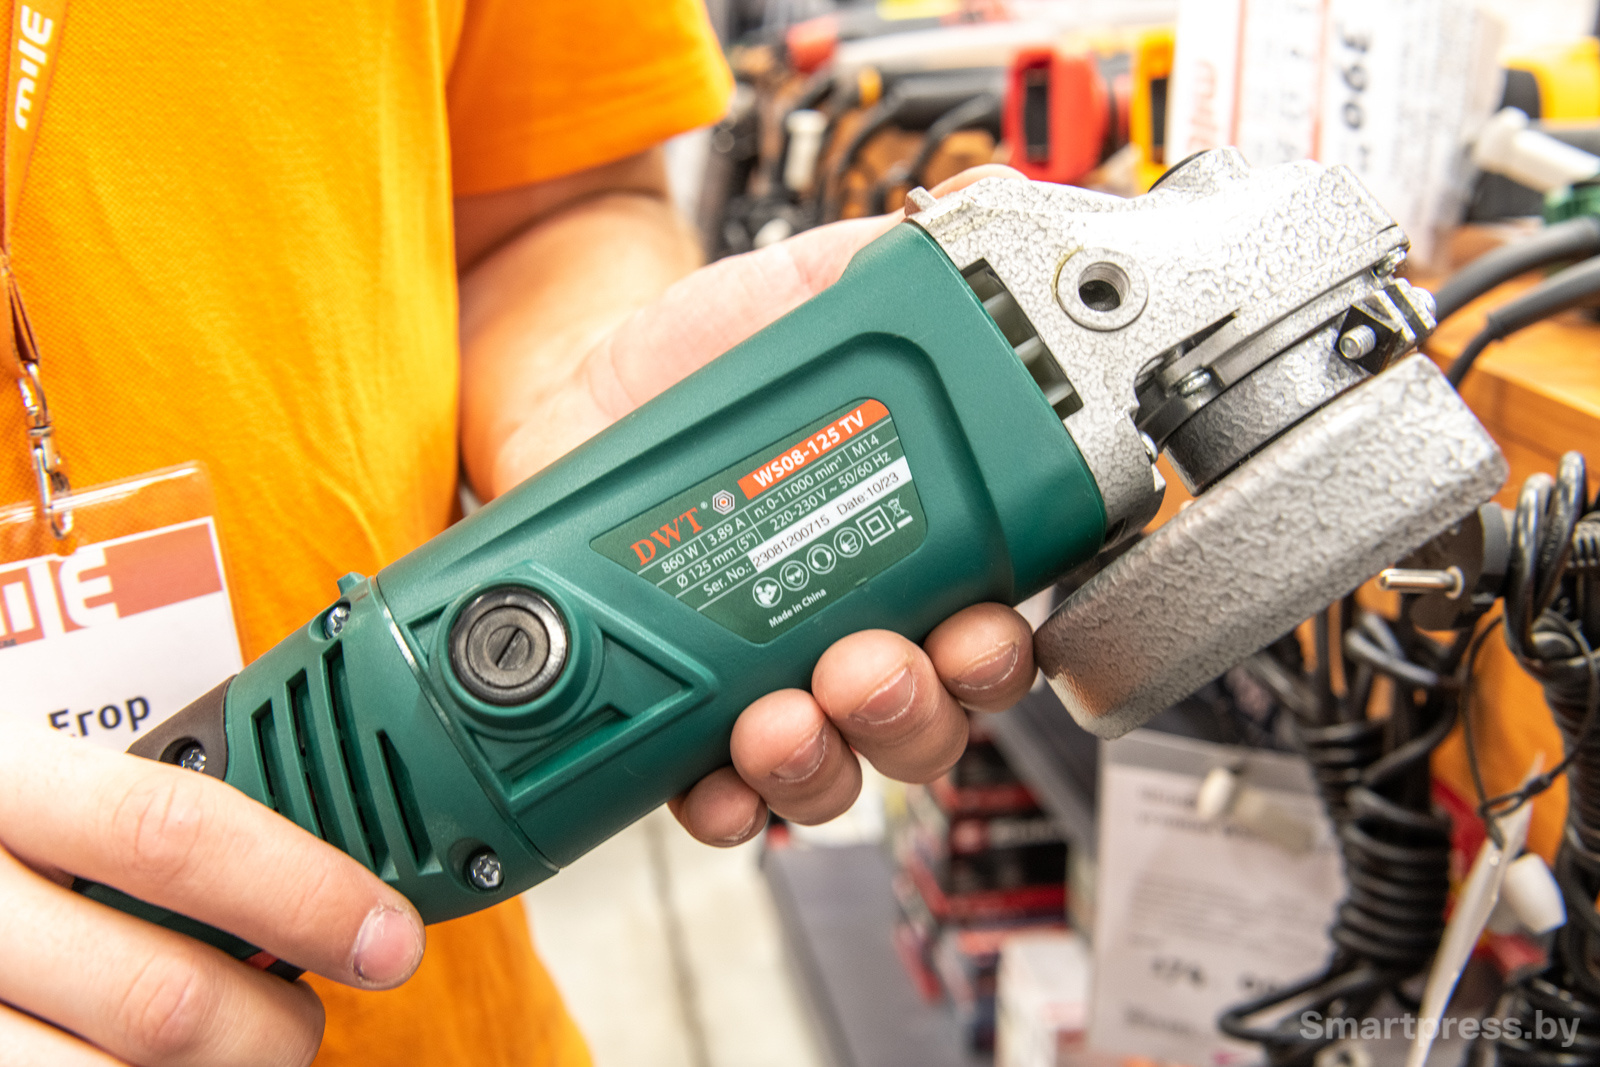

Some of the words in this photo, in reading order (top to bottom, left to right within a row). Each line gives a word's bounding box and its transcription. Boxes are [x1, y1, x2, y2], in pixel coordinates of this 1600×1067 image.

[753, 427, 841, 489] WS08-125
[839, 410, 865, 435] TV
[852, 434, 880, 458] M14
[766, 474, 815, 511] 0-11000
[770, 497, 819, 532] 220-230
[817, 489, 829, 503] V
[841, 461, 875, 491] 50/60
[874, 450, 892, 468] Hz
[630, 507, 704, 567] DWT
[735, 517, 747, 531] A
[661, 553, 685, 575] 860
[684, 543, 700, 558] W
[689, 560, 712, 583] 125
[713, 547, 737, 567] mm
[703, 576, 728, 598] Ser.
[752, 516, 831, 569] 23081200715
[769, 609, 793, 629] Made
[792, 602, 803, 614] in
[801, 589, 828, 609] China
[48, 695, 151, 737] Егор
